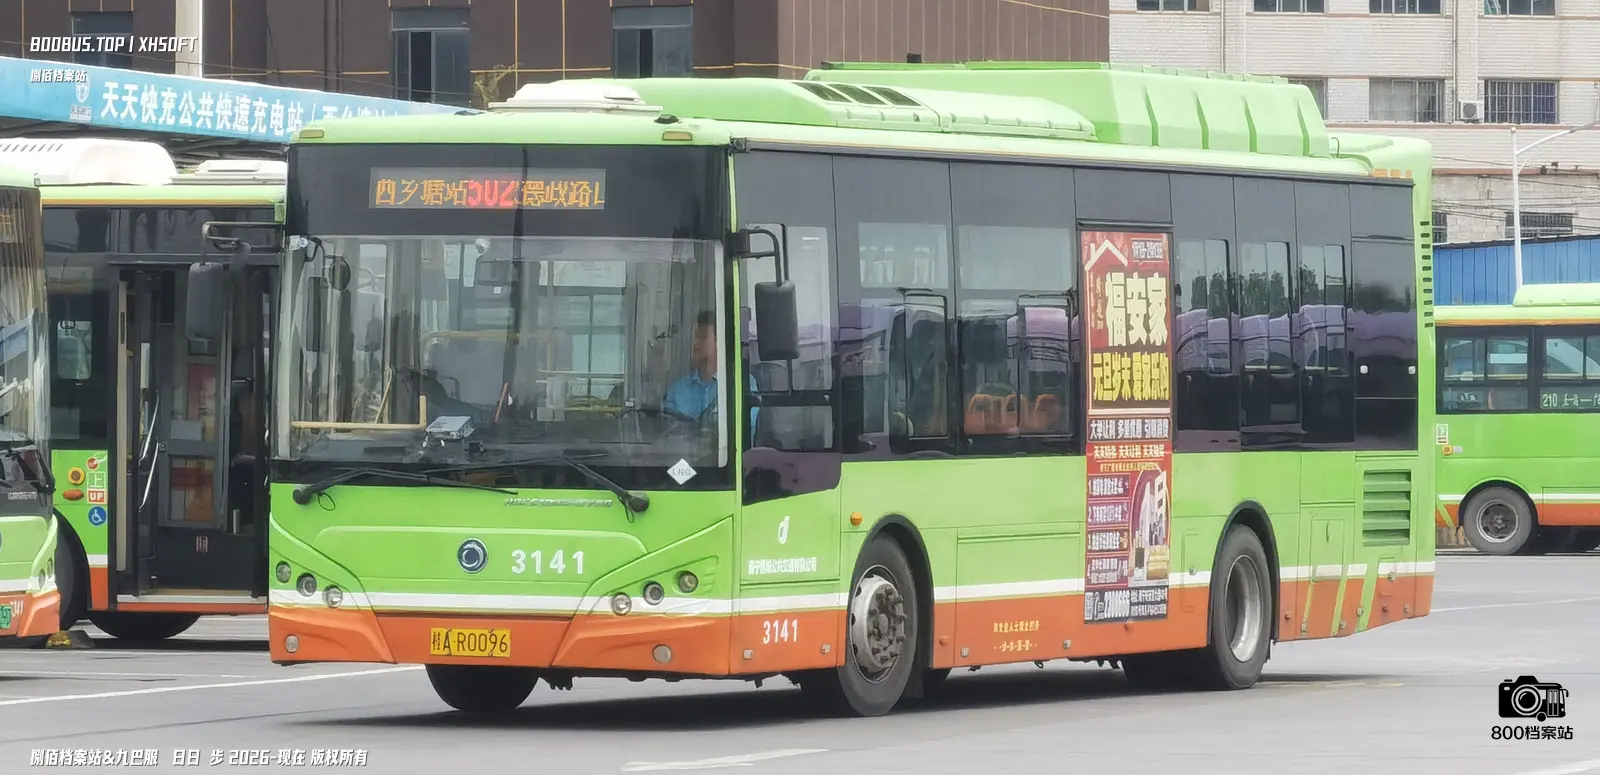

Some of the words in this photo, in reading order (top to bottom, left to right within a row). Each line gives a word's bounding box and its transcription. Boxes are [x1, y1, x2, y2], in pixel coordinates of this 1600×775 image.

[101, 81, 304, 136] 天天快充公共快速充电站
[1105, 271, 1168, 346] 福安家
[1543, 393, 1558, 407] 210
[90, 473, 104, 488] 上
[90, 492, 103, 501] UP
[511, 550, 584, 574] 3141
[763, 618, 798, 644] 3141
